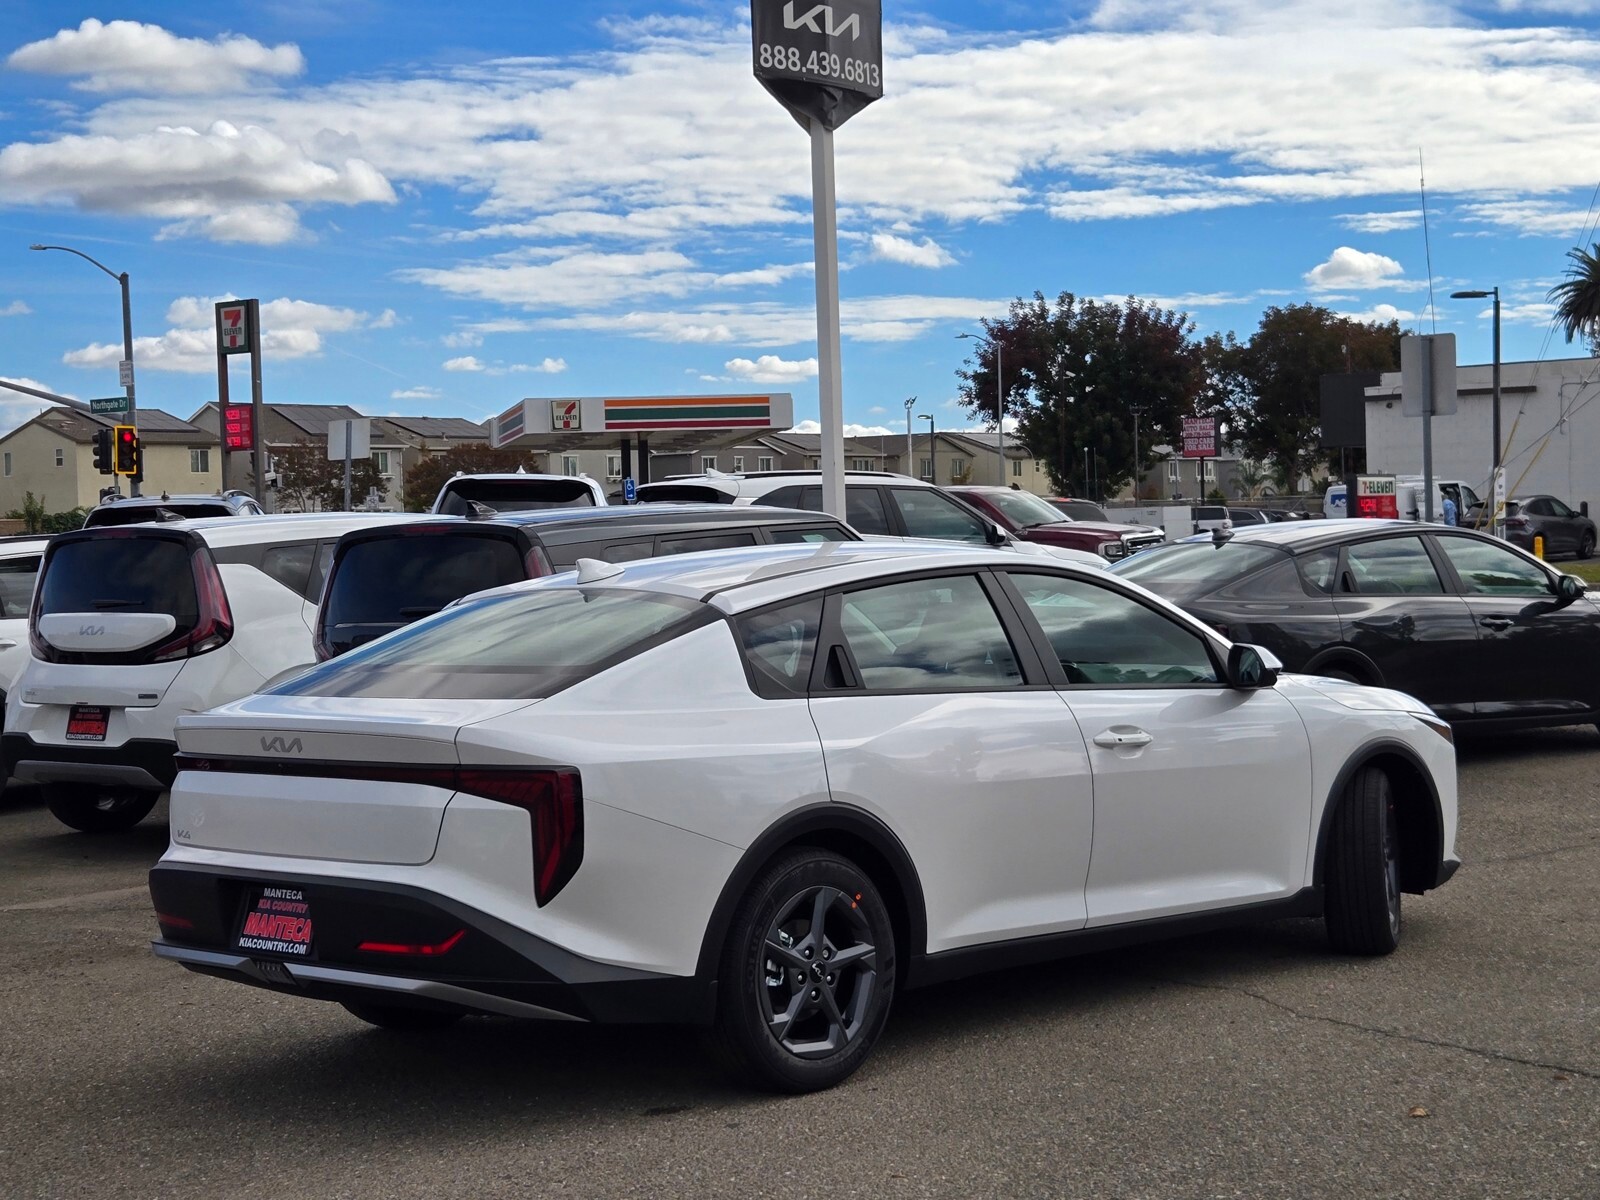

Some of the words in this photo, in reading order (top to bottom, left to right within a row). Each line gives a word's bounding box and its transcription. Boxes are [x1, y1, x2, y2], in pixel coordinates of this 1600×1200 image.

[783, 0, 859, 41] KIA
[760, 43, 880, 87] 888.439.6813
[92, 400, 118, 411] Northgate
[120, 399, 126, 408] Dr
[261, 736, 303, 753] KIA
[177, 829, 191, 840] K4
[263, 887, 303, 900] MANTECA
[257, 898, 271, 910] KIA
[271, 900, 309, 914] COUNTRY
[243, 911, 312, 943] MANTECA
[238, 937, 307, 955] KIACOUNTRY.COM
